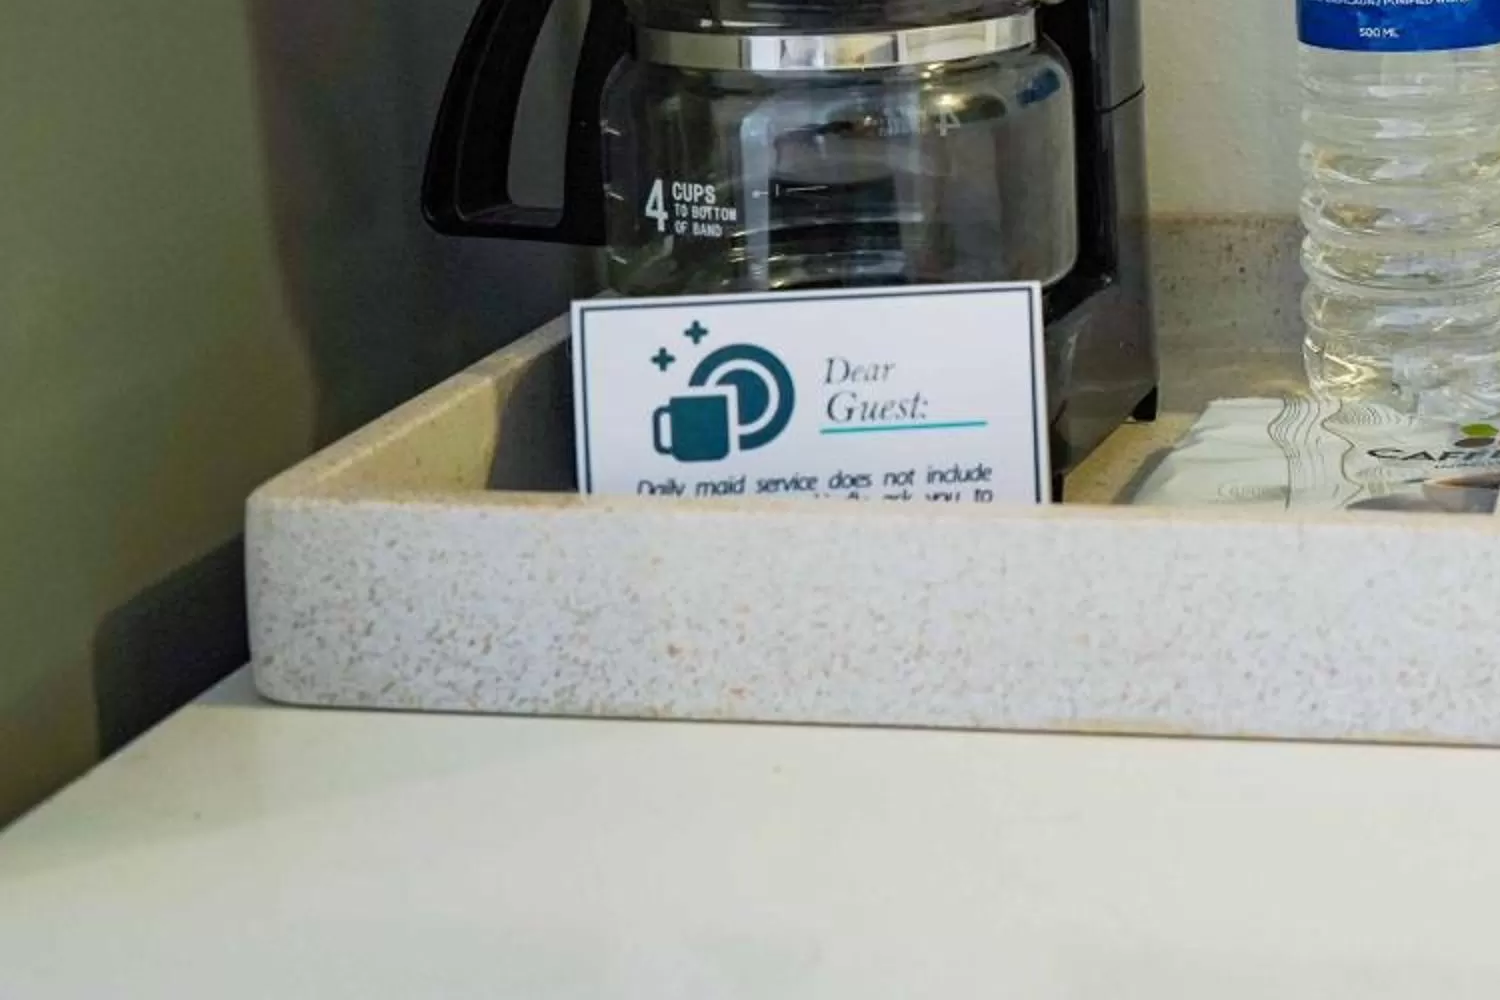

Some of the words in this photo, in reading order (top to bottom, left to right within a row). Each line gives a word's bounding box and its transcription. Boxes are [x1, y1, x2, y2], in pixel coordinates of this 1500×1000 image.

[1359, 27, 1381, 38] 500
[645, 177, 669, 232] 4
[672, 181, 717, 204] CUPS
[673, 203, 689, 218] TO
[691, 204, 737, 221] BOTTOM
[675, 220, 689, 234] OF
[824, 356, 897, 384] Dear
[827, 391, 929, 421] Guest:
[695, 474, 746, 497] maid
[756, 472, 817, 493] service
[828, 469, 873, 490] does
[883, 468, 916, 487] not
[927, 462, 993, 484] include
